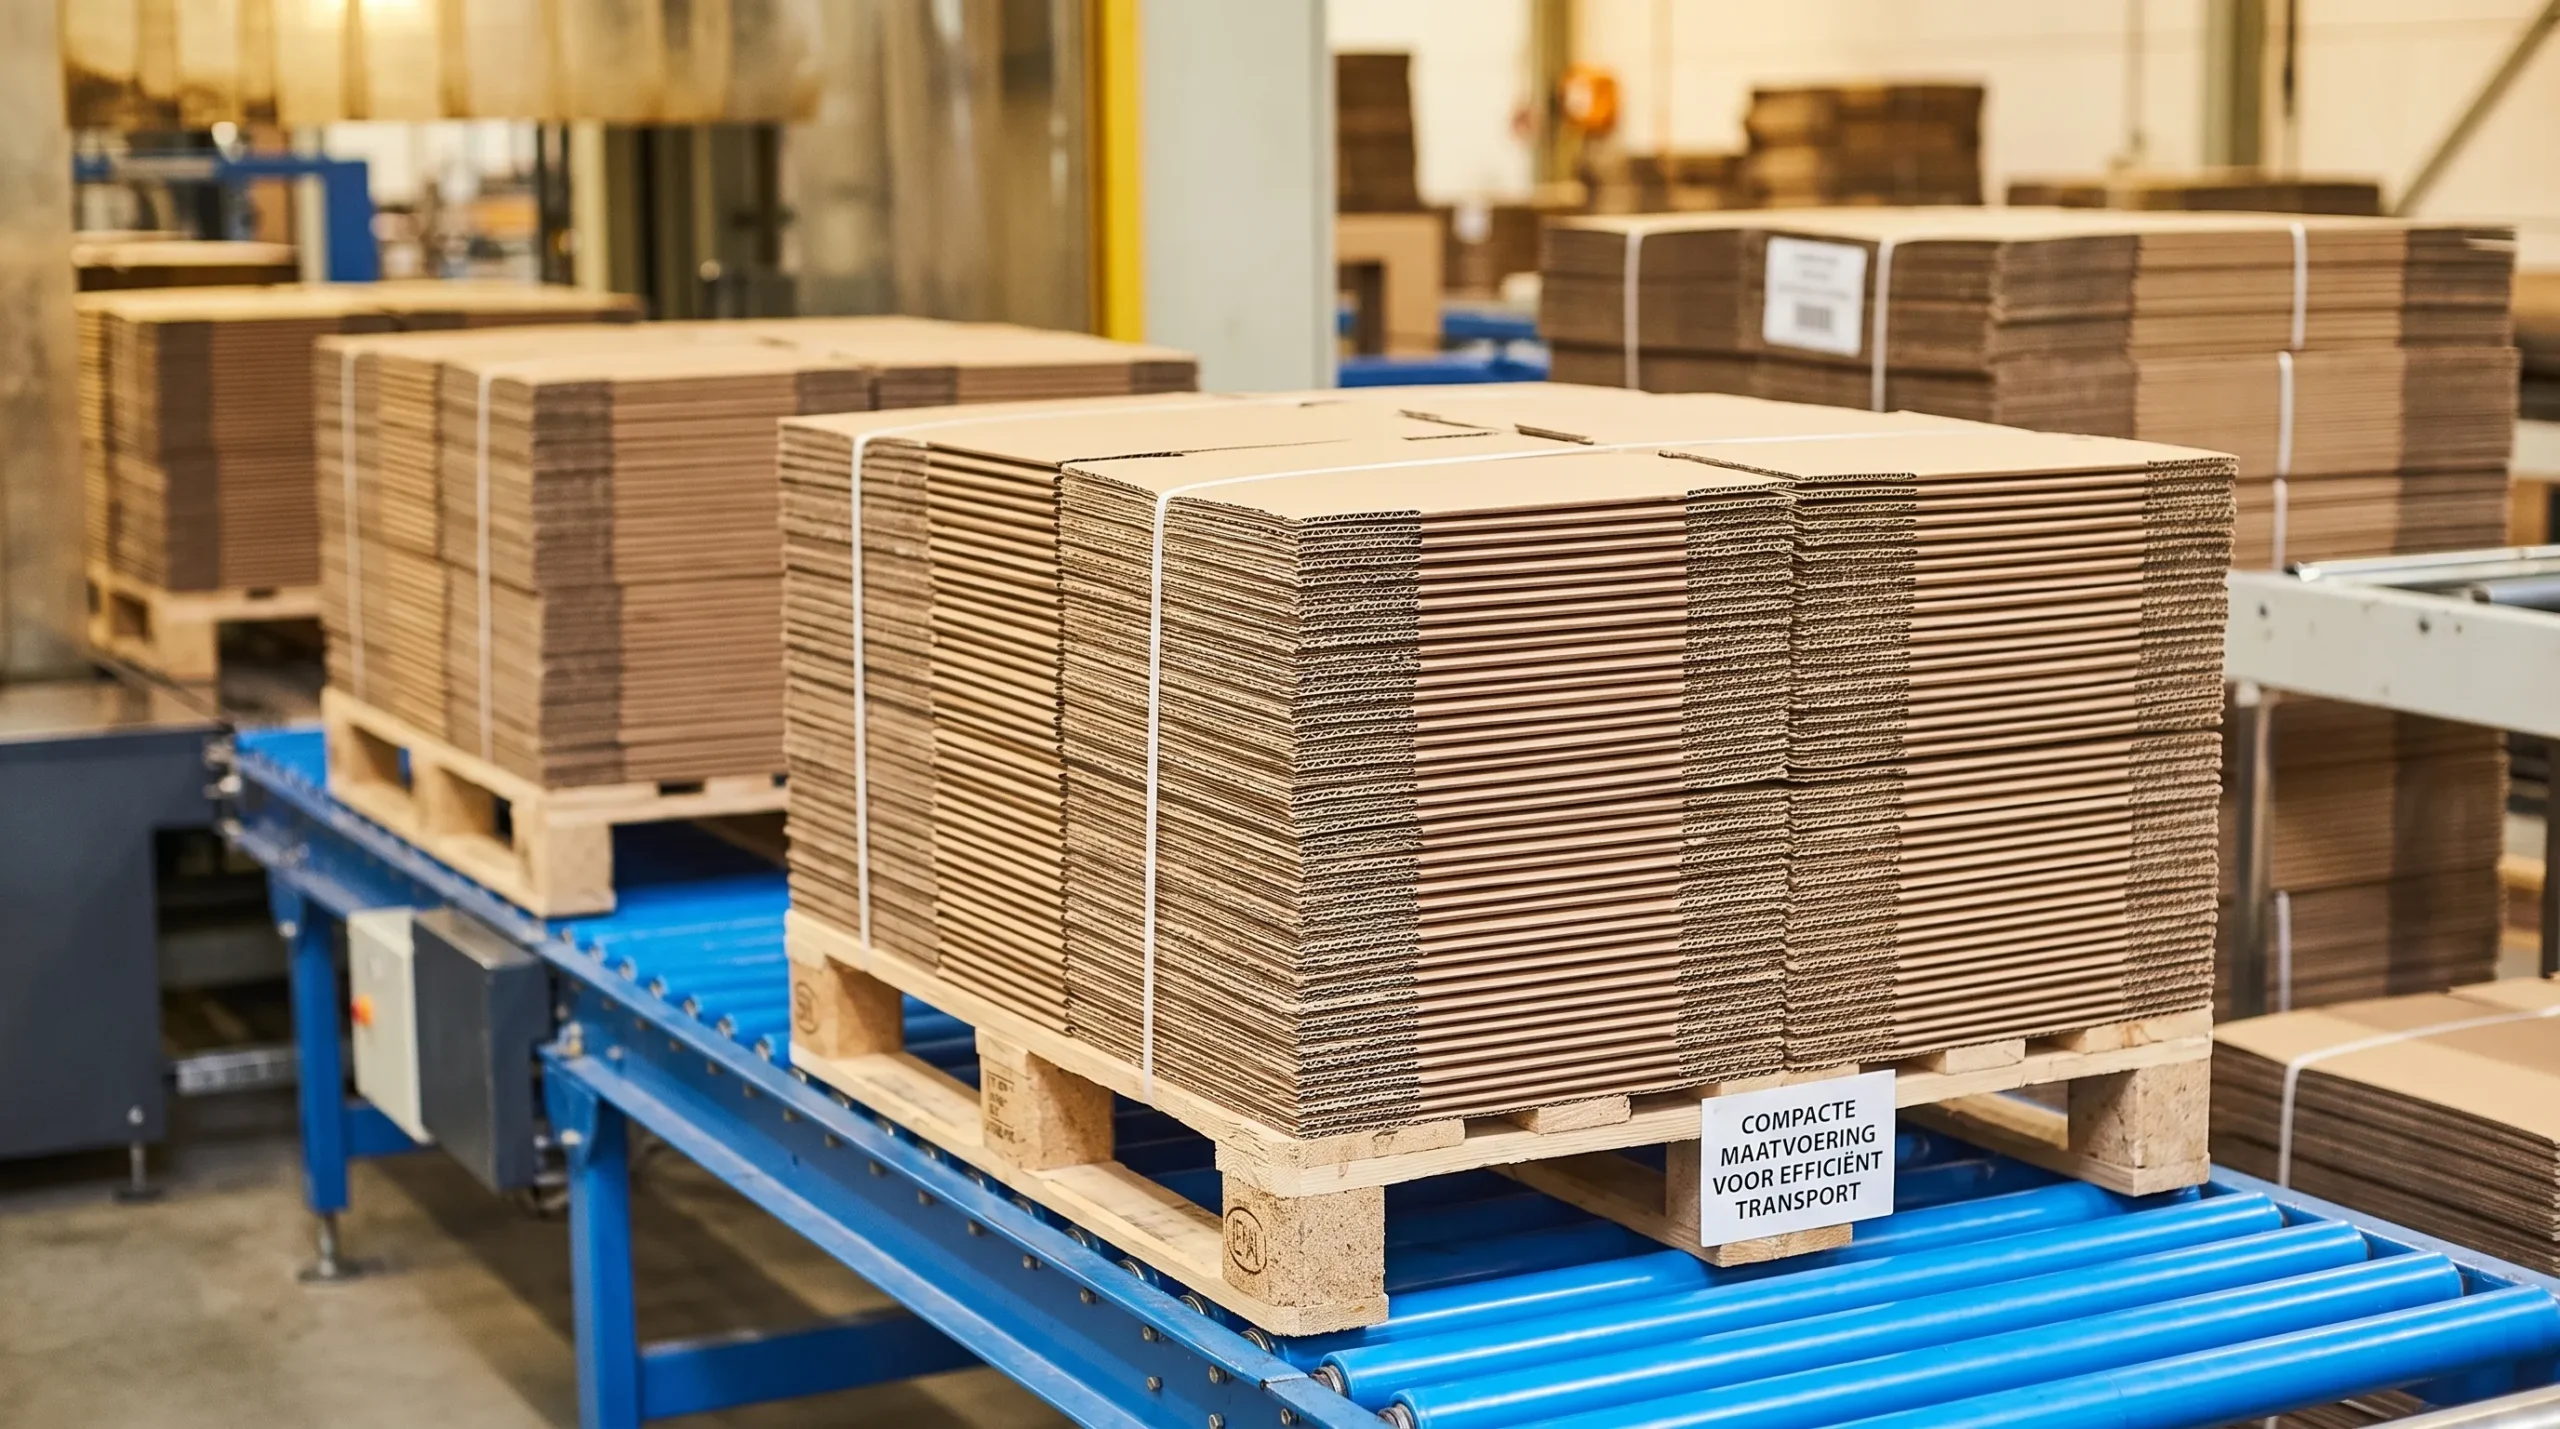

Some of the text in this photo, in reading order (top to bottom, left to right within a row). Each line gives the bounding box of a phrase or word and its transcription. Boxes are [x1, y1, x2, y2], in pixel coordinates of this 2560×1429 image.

[1741, 1099, 1856, 1134] COMPACTE
[1720, 1124, 1876, 1167] MAATVOERING
[1712, 1150, 1883, 1195] VOOR EFFICIËNT
[1735, 1181, 1862, 1220] TRANSPORT
